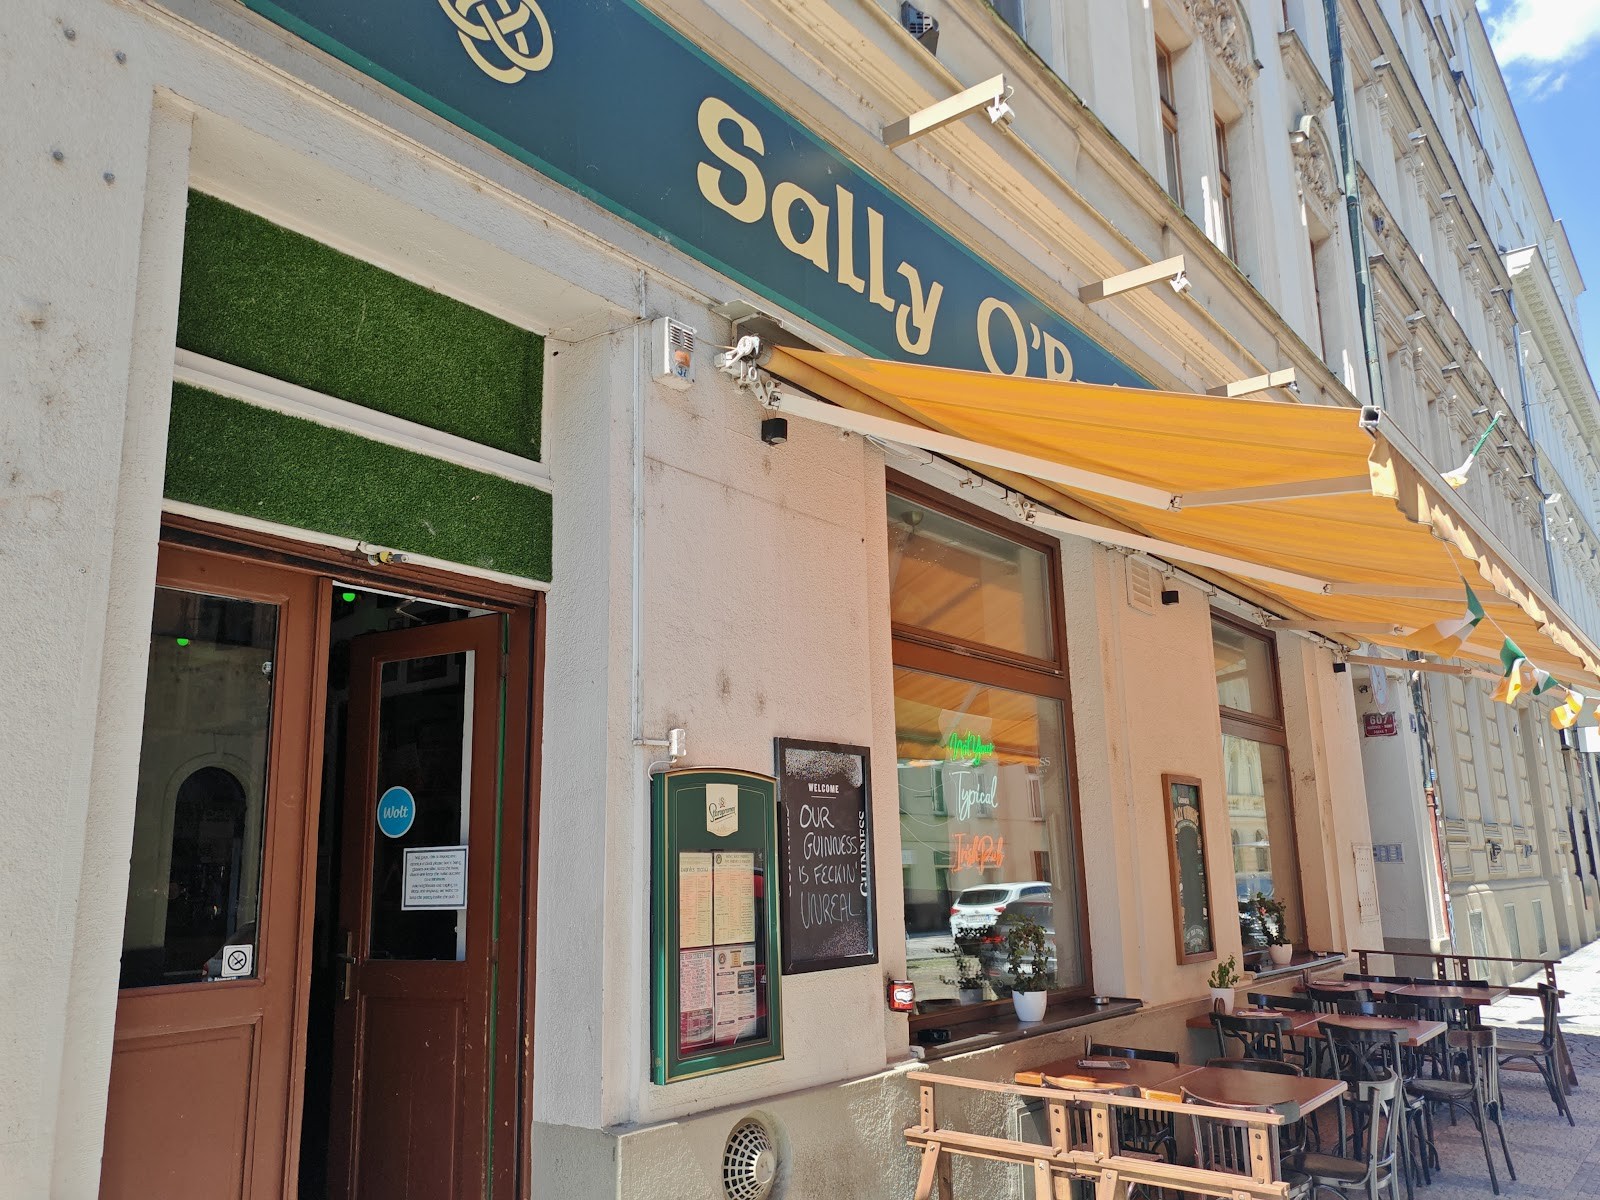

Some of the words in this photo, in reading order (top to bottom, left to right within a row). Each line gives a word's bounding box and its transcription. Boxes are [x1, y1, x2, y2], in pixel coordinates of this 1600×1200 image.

[697, 96, 944, 355] Sally
[808, 783, 839, 794] WELCOME
[951, 771, 998, 821] Typical
[383, 805, 408, 819] Wolt
[799, 804, 835, 829] OUR
[803, 832, 859, 860] GUINNESS
[799, 866, 809, 885] IS
